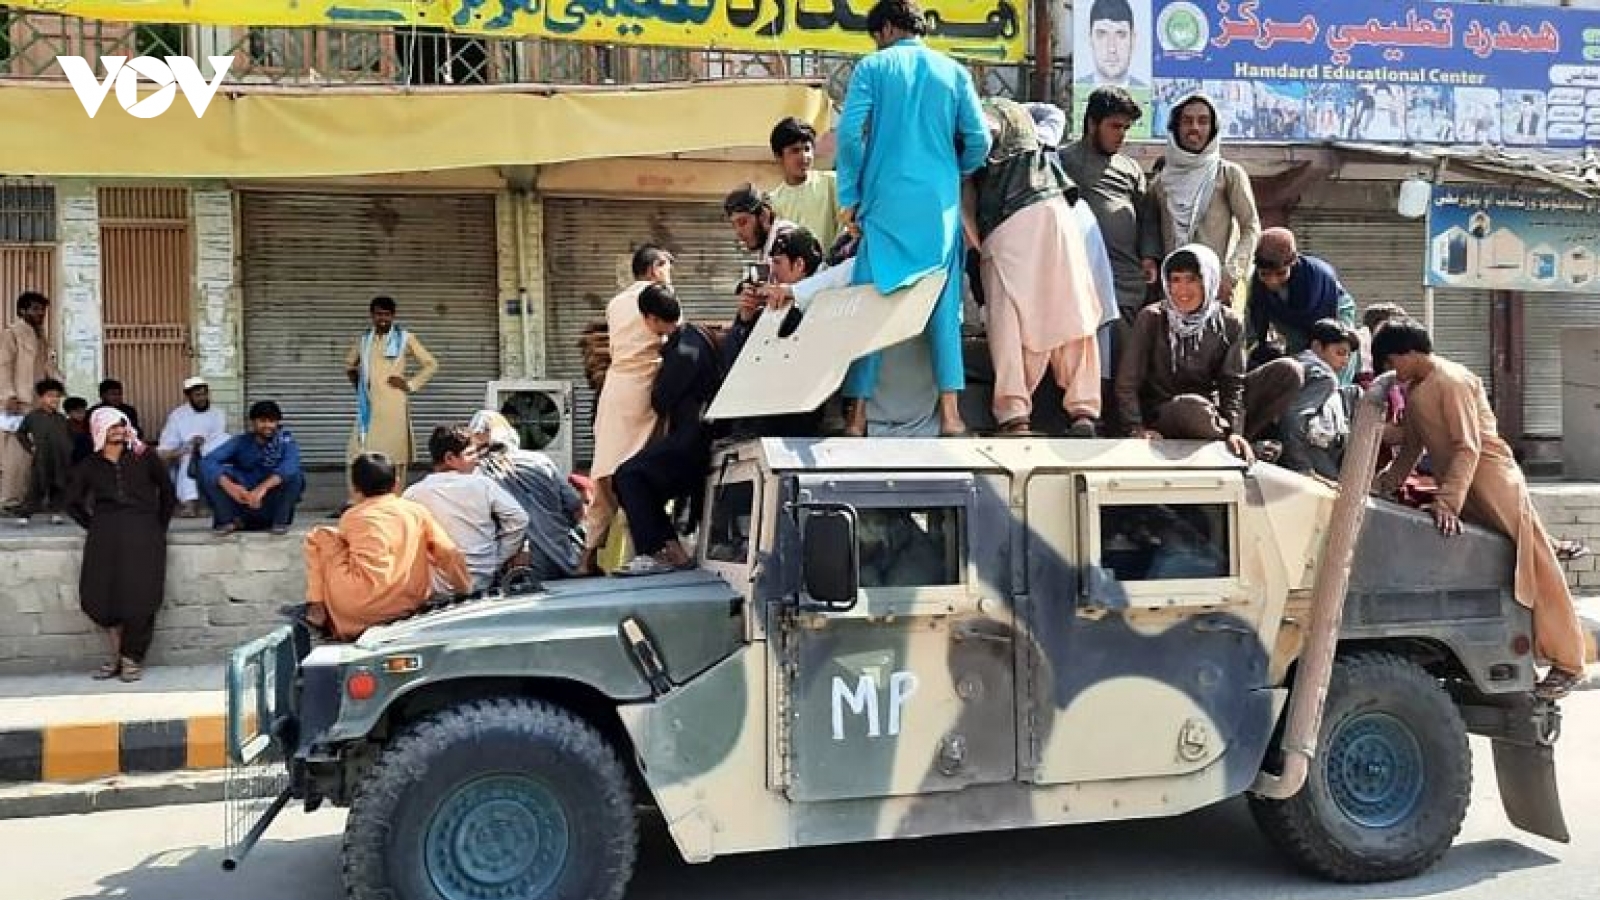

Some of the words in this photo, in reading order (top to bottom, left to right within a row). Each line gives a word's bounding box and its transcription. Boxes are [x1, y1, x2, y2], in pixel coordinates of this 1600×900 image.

[1463, 20, 1560, 58] همدرد
[1234, 62, 1318, 79] Hamdard
[1322, 65, 1426, 82] Educational
[1428, 68, 1487, 85] Center
[831, 669, 919, 740] MP
